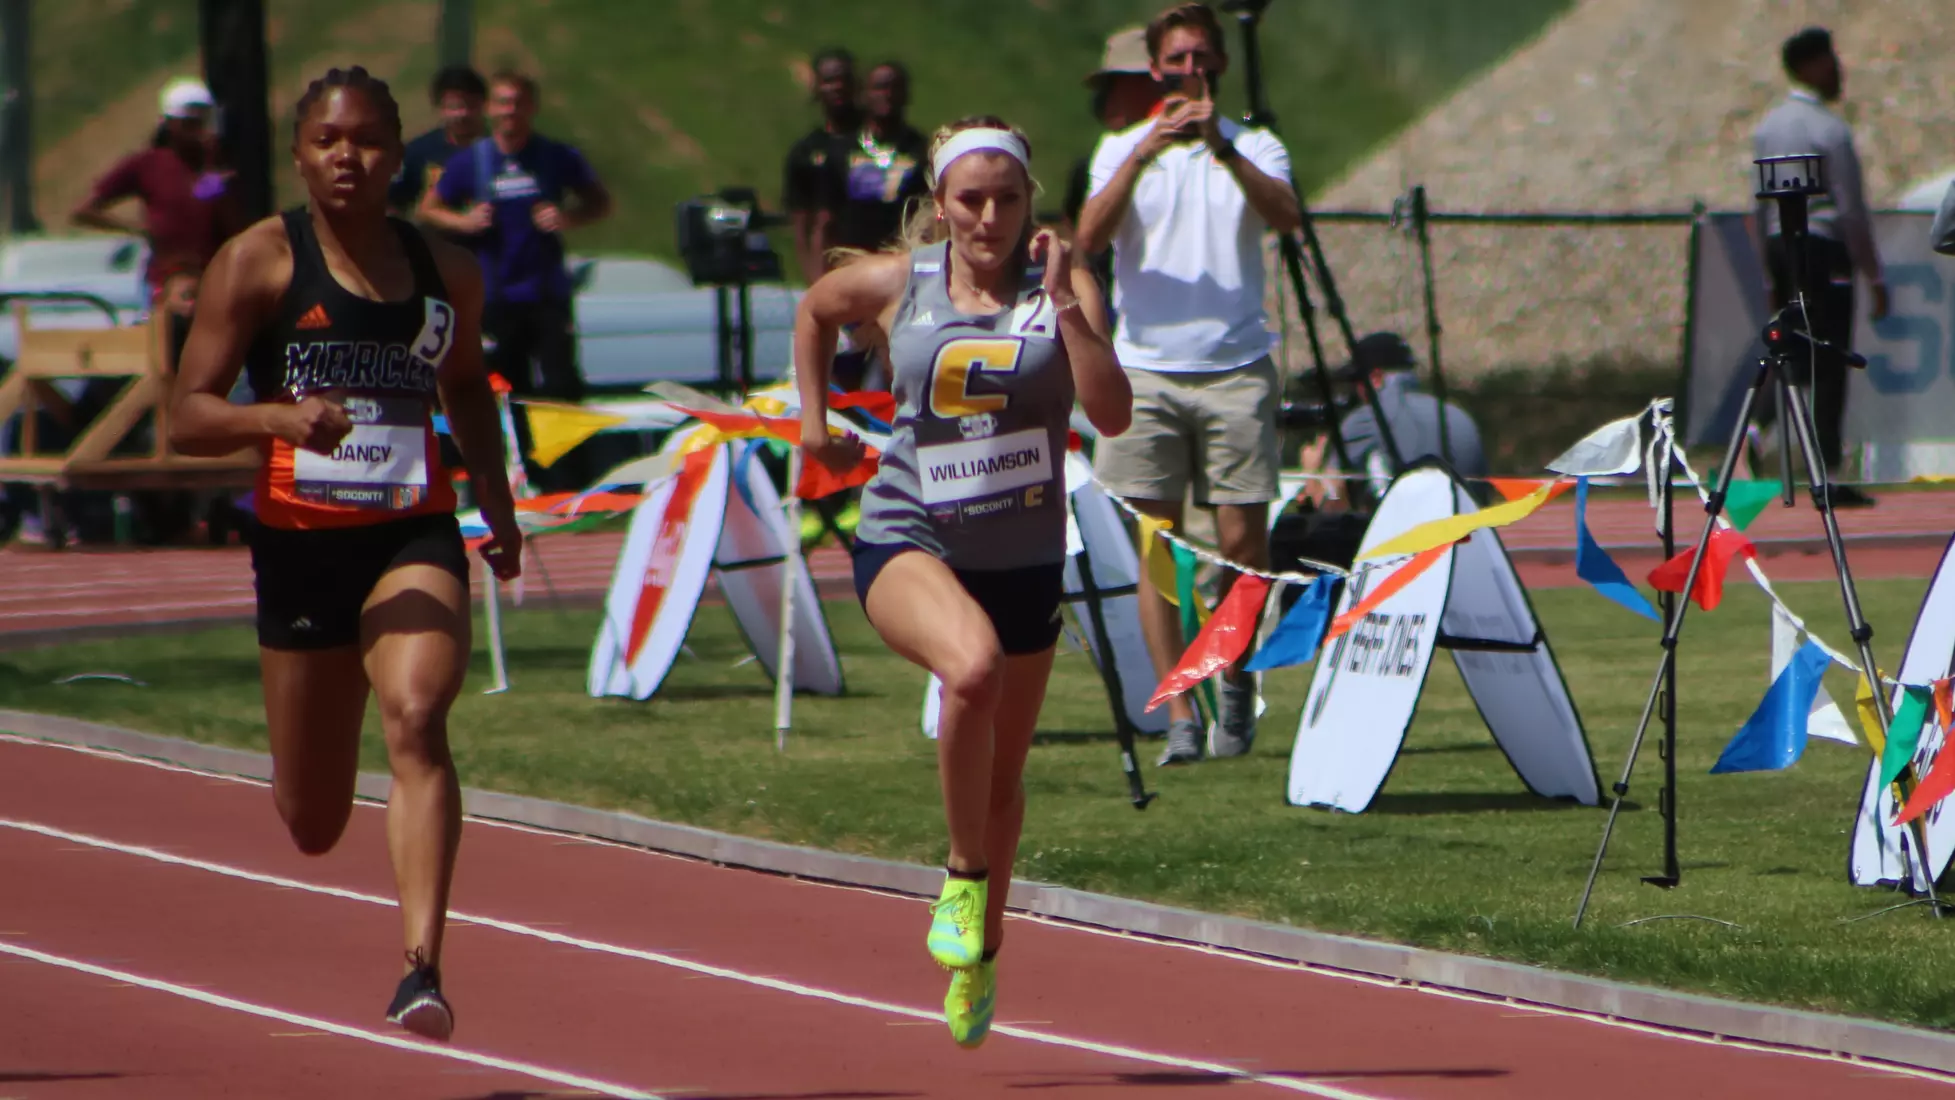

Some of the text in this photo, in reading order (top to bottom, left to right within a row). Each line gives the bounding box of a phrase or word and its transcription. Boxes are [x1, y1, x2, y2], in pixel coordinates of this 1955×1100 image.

[419, 304, 450, 360] 3
[1020, 287, 1046, 334] 2
[1866, 264, 1955, 394] S
[283, 341, 436, 393] MERCE
[928, 336, 1026, 419] C
[331, 444, 392, 463] DANCY
[929, 447, 1041, 483] WILLIAMSON
